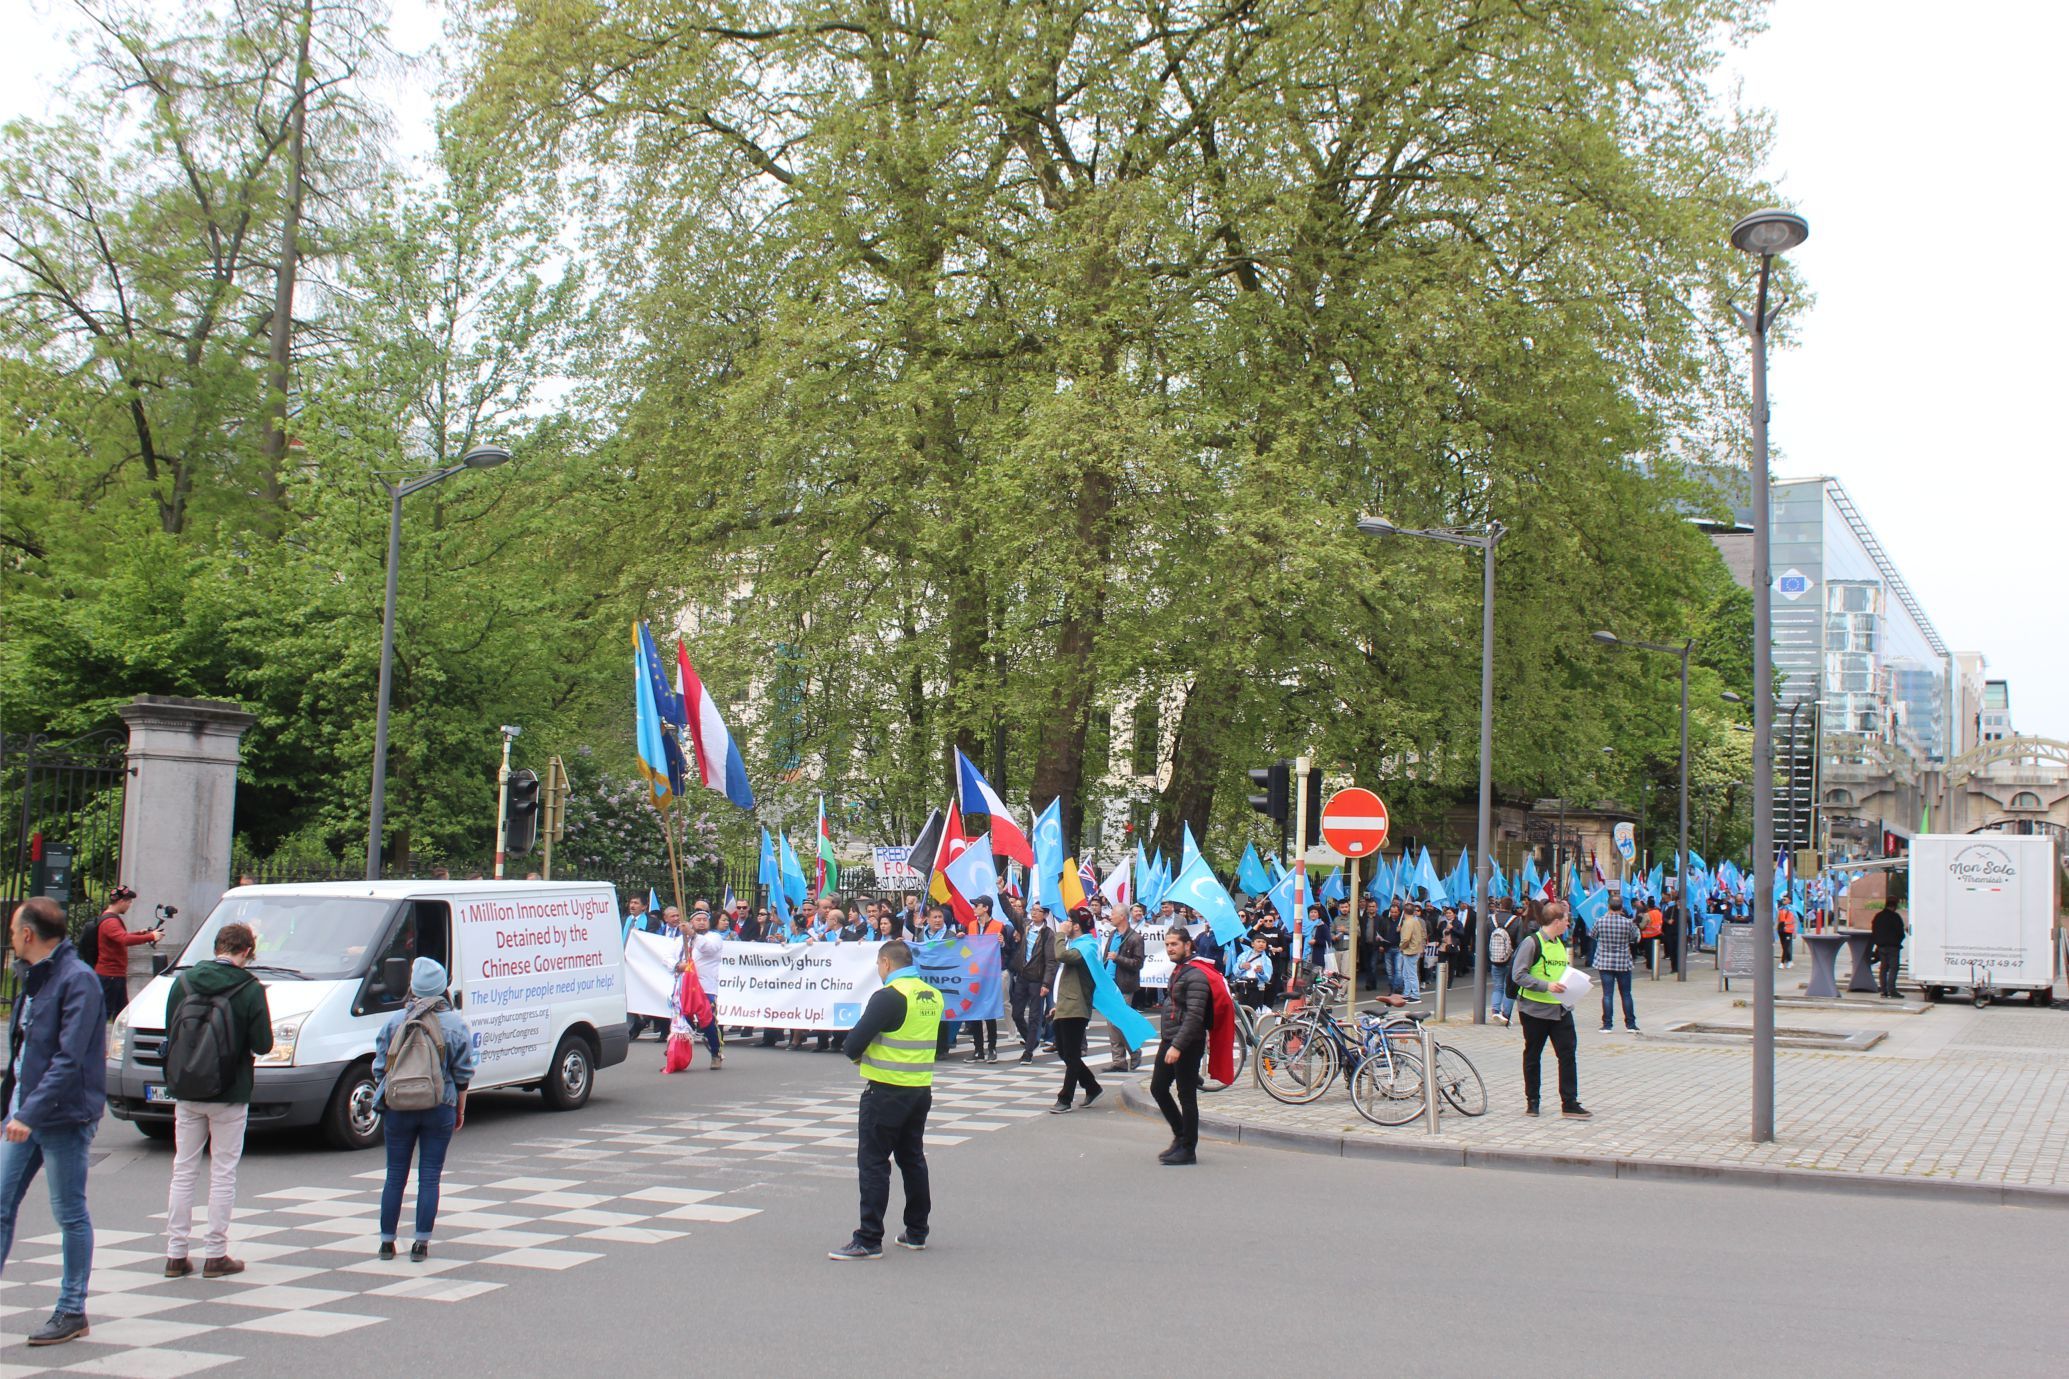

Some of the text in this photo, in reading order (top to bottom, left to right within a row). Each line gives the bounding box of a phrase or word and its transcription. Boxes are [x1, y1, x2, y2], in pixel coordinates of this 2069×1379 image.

[876, 847, 911, 862] FREEDO
[1950, 861, 2017, 876] Non Solo
[460, 897, 610, 923] 1 Million Innocent Uyghur
[495, 923, 589, 949] Detained by the
[482, 950, 604, 979] Chinese Government
[738, 954, 781, 968] Million
[781, 953, 833, 971] Uyghurs
[1944, 957, 1960, 966] Tel
[1985, 959, 1996, 967] 13
[1997, 959, 2010, 967] 49
[2011, 960, 2024, 968] 47
[471, 974, 615, 1006] The Uyghur people need your help!
[749, 976, 803, 991] Detained
[805, 977, 817, 991] in
[820, 978, 854, 991] China
[471, 1007, 550, 1028] www.uyghurcongress.org
[730, 1005, 762, 1018] Must
[763, 1007, 801, 1020] Speak
[804, 1008, 825, 1024] Up!
[482, 1026, 540, 1045] @UyghurCongress
[480, 1043, 538, 1063] @UyghurCongress
